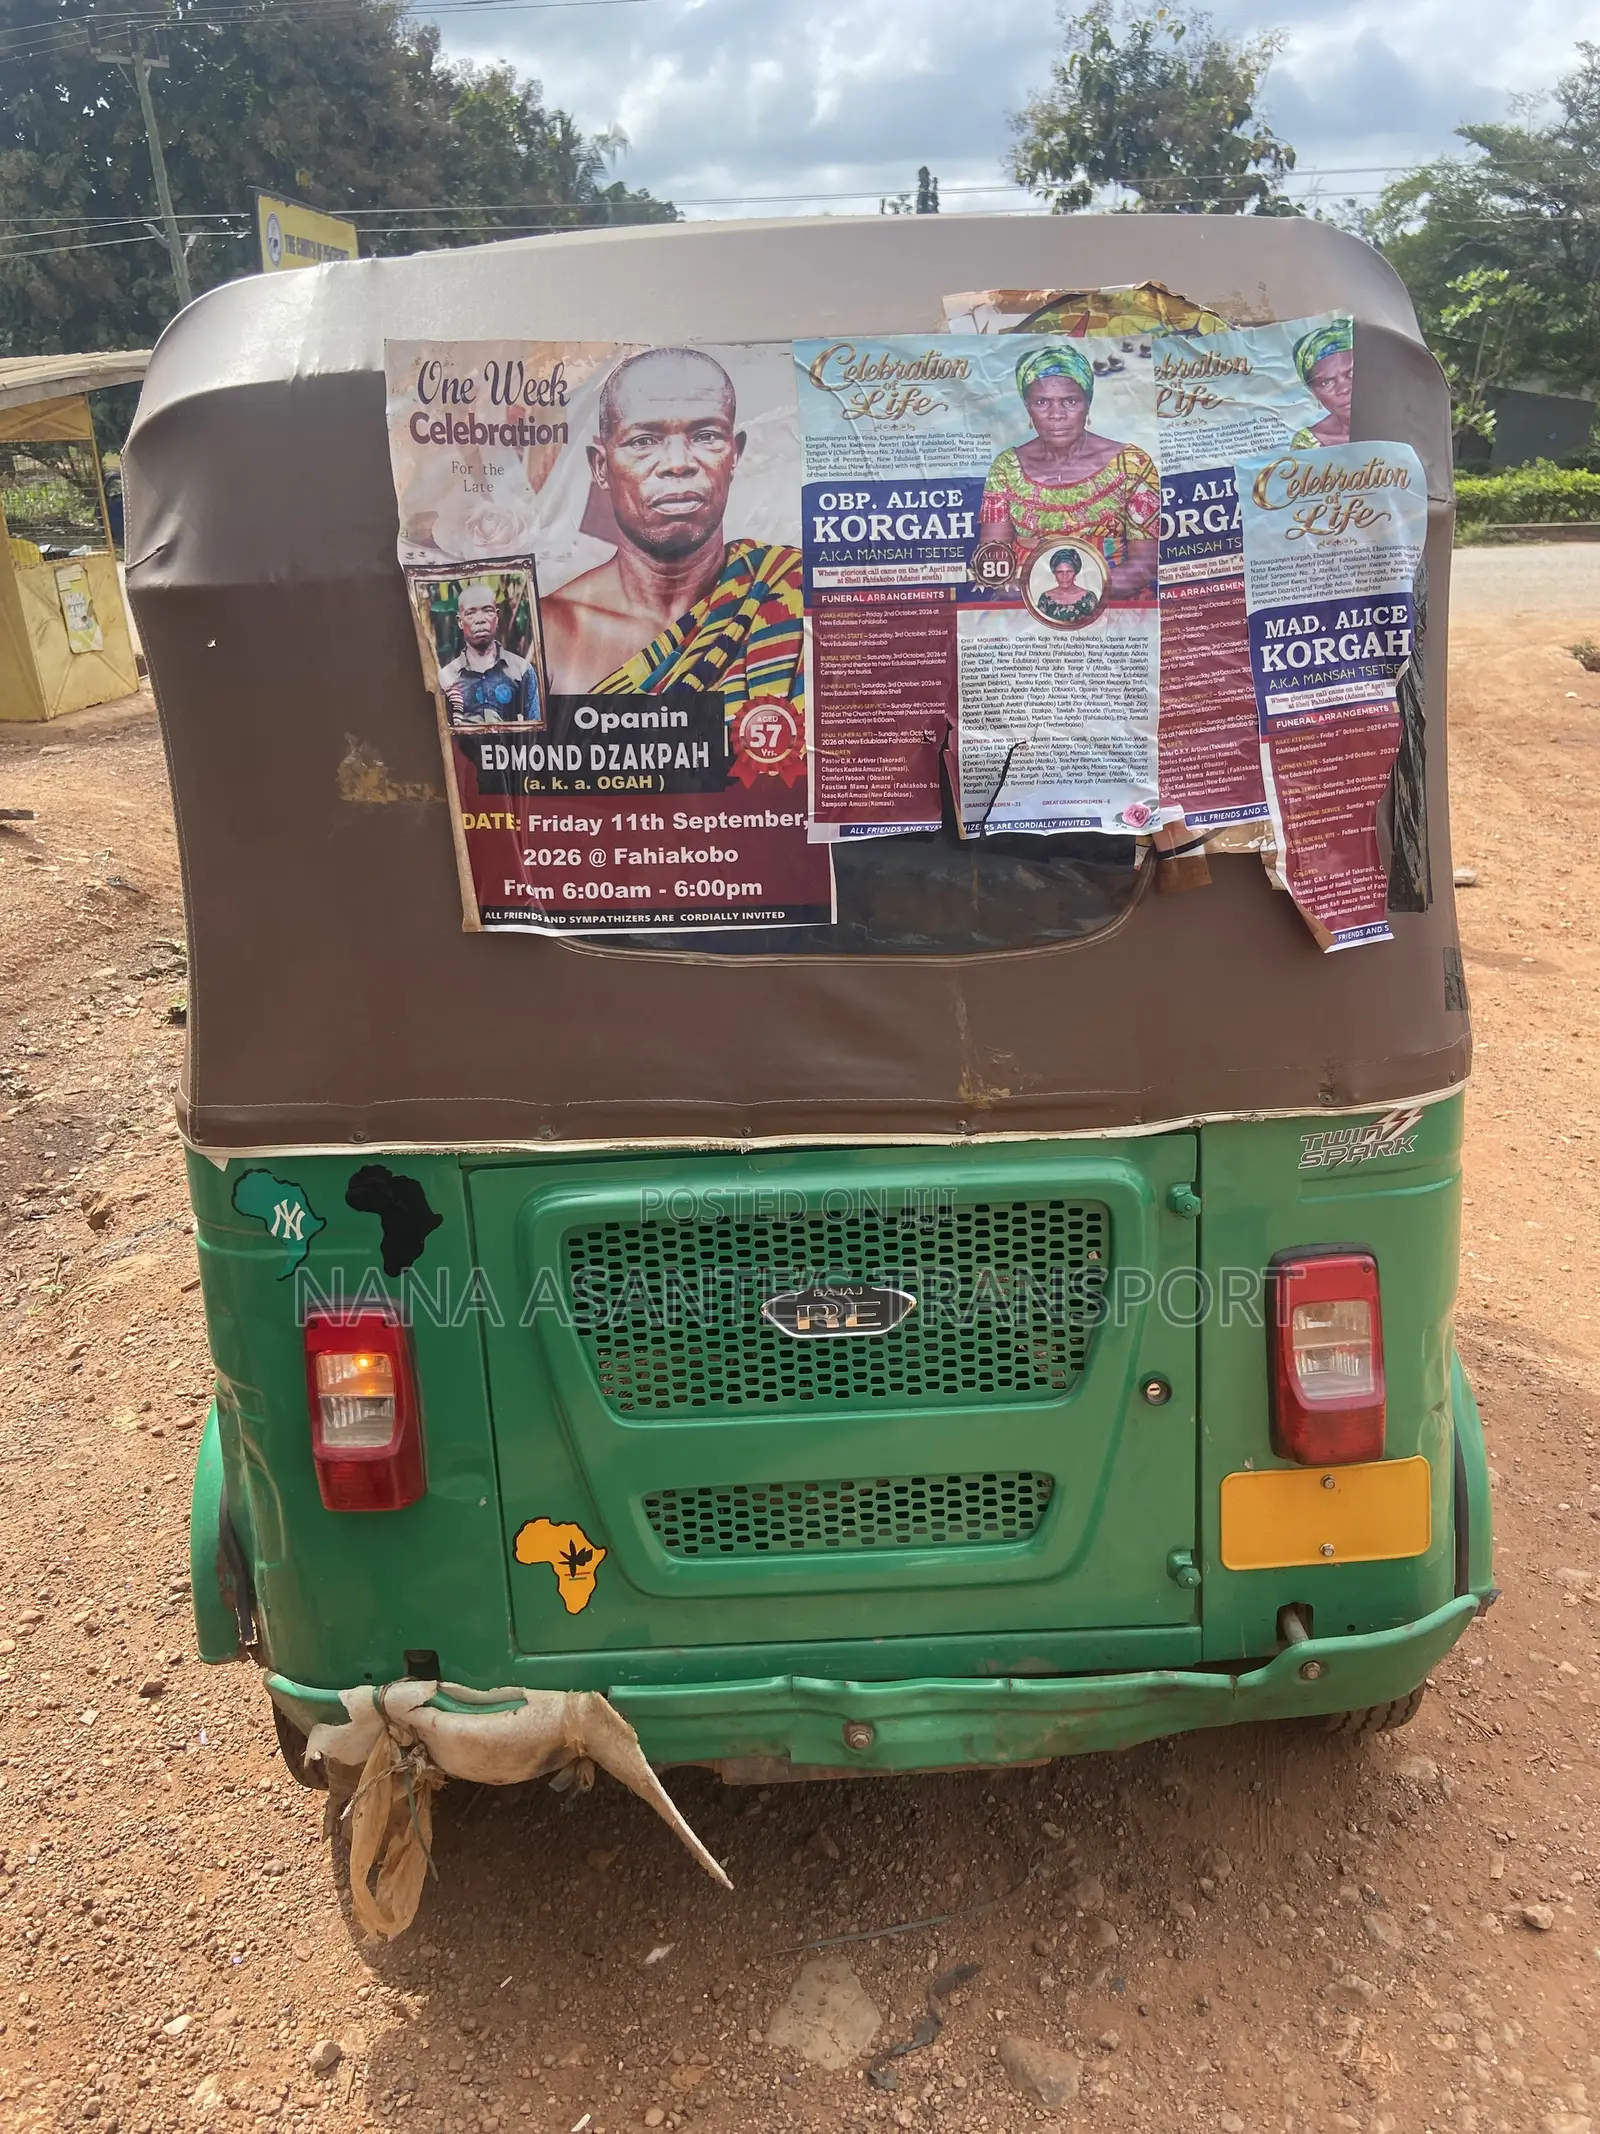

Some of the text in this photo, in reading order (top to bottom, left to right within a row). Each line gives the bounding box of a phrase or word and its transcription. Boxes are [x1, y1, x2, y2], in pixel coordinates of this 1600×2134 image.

[808, 342, 972, 391] Celebration
[417, 360, 571, 407] One Week
[883, 380, 898, 390] of
[840, 387, 949, 420] Life
[409, 411, 569, 447] Celebration
[451, 461, 505, 476] For the
[463, 480, 494, 492] Late
[1252, 456, 1412, 511] Celebration
[818, 489, 963, 511] OBP. ALICE
[1325, 492, 1340, 505] of
[813, 512, 975, 543] KORGAH
[1284, 497, 1392, 540] Life
[819, 546, 965, 562] A.K.A MANSAH TSETSE
[982, 552, 1008, 560] AGED
[1167, 541, 1222, 559] MANSAH
[817, 569, 839, 577] Whose
[840, 568, 866, 578] glorious
[929, 565, 945, 574] April
[844, 576, 861, 584] Shell
[863, 575, 895, 584] Fahiakobo
[896, 574, 920, 583] (Adansi
[921, 573, 942, 582] south)
[983, 561, 1009, 578] 80
[1251, 582, 1269, 590] Pastor
[1271, 579, 1290, 587] Daniel
[821, 591, 945, 603] FUNERAL ARRANGEMENTS
[1265, 605, 1408, 640] MAD. ALICE
[1260, 629, 1412, 673] KORGAH
[1269, 678, 1300, 690] A.K.A
[1303, 667, 1356, 686] MANSAH
[1290, 693, 1314, 704] glorious
[1329, 688, 1345, 696] came
[1371, 681, 1386, 691] April
[574, 706, 688, 733] Opanin
[756, 715, 778, 723] AGED
[1276, 705, 1389, 728] FUNERAL ARRANGEMENTS
[750, 724, 782, 748] 57
[480, 742, 709, 771] EDMOND DZAKPAH
[761, 748, 778, 757] Yrs.
[523, 776, 546, 793] (a.
[551, 776, 569, 790] k.
[574, 779, 591, 790] a.
[597, 775, 652, 789] OGAH
[462, 810, 808, 836] DATE: Friday 11th September,
[1014, 821, 1056, 829] CORDIALLY
[1058, 819, 1091, 827] INVITED
[1194, 815, 1207, 823] ALL
[1210, 811, 1240, 821] FRIENDS
[1243, 808, 1260, 816] AND
[866, 825, 901, 834] FRIENDS
[903, 824, 922, 832] AND
[523, 846, 739, 867] 2026 @ Fahiakobo
[504, 879, 554, 899] From
[562, 881, 651, 899] 6:00am
[674, 879, 763, 900] 6:00pm
[504, 912, 542, 921] FRIENDS
[544, 915, 566, 924] AND
[569, 914, 651, 924] SYMPATHIZERS
[654, 914, 675, 922] ARE
[680, 912, 739, 922] CORDIALLY
[742, 911, 786, 920] INVITED
[1338, 931, 1364, 941] FRIENDS
[1366, 927, 1382, 936] AND
[1300, 1124, 1384, 1152] TWIN
[1298, 1134, 1418, 1169] SPARK
[813, 1286, 862, 1297] BAJAJ
[796, 1301, 882, 1330] RE
